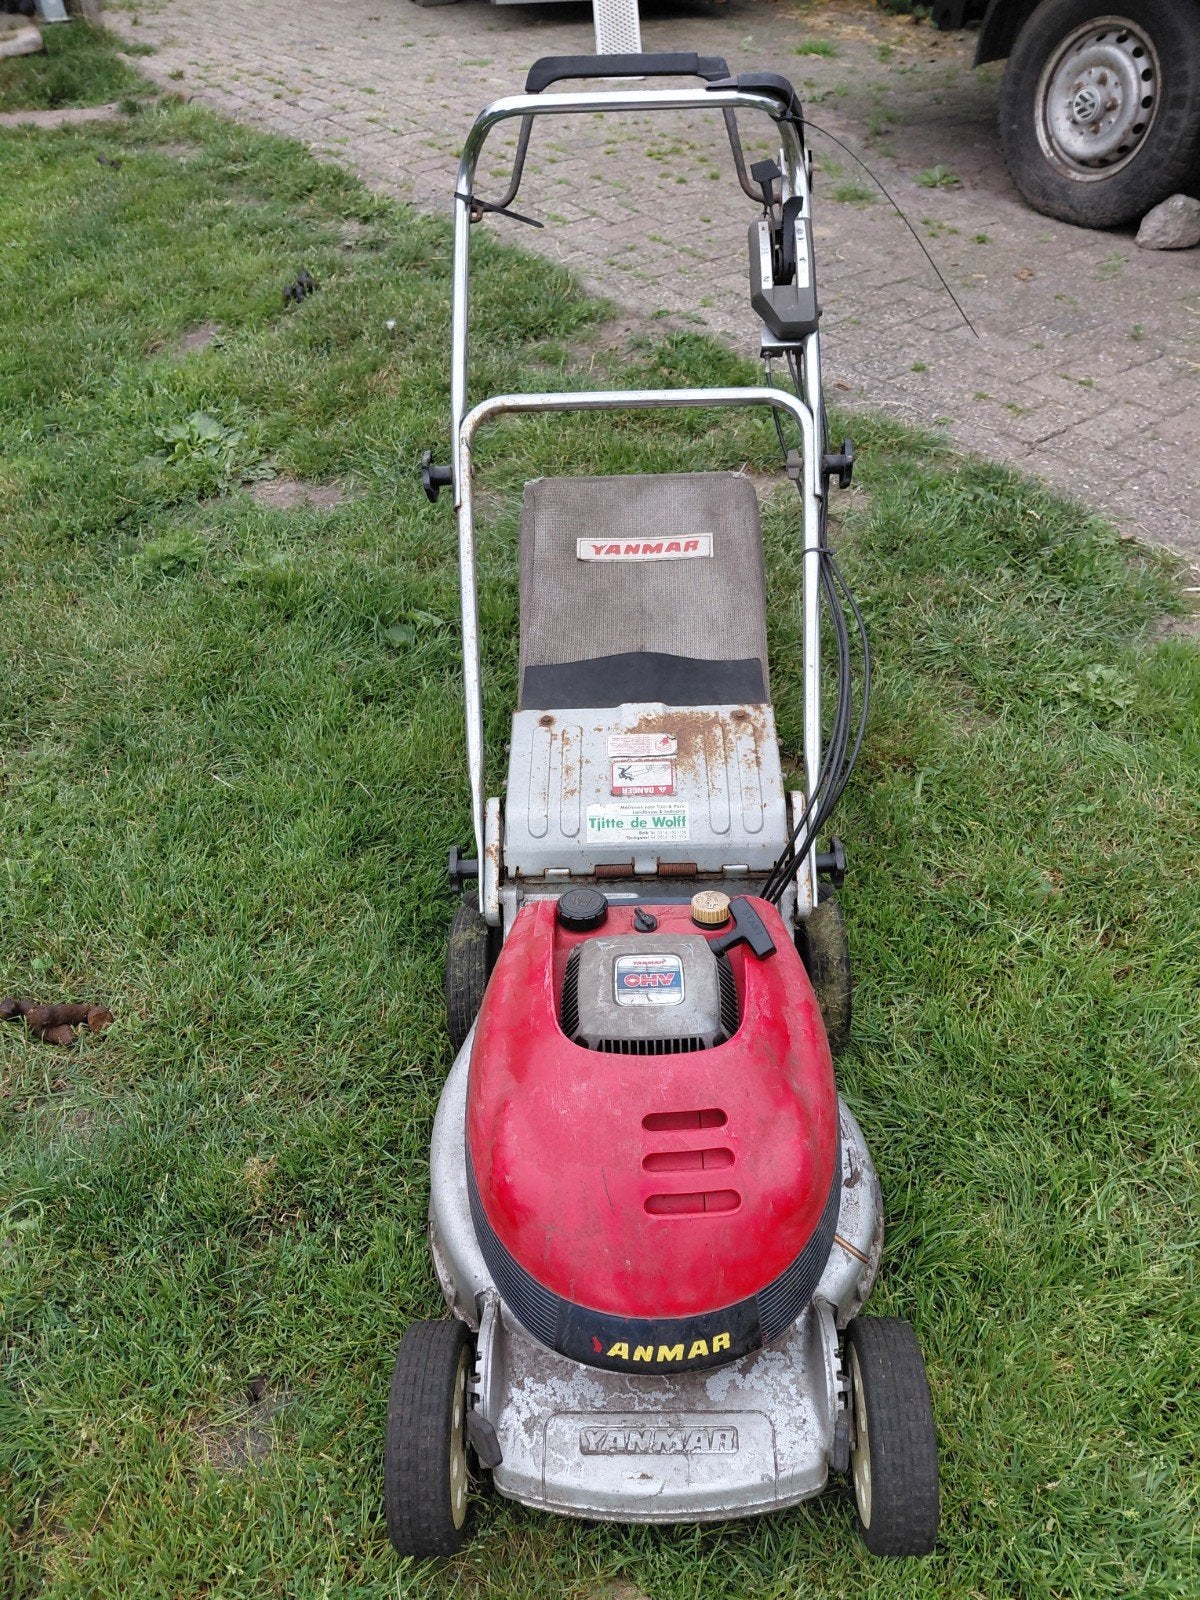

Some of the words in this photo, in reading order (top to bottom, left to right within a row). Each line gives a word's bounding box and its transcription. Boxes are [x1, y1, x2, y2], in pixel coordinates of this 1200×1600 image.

[590, 540, 700, 556] YANMAR
[588, 817, 624, 831] Tjitte
[630, 816, 647, 828] de
[651, 815, 687, 827] Wolff
[623, 972, 676, 988] OHV
[584, 1428, 735, 1452] YANMAR
